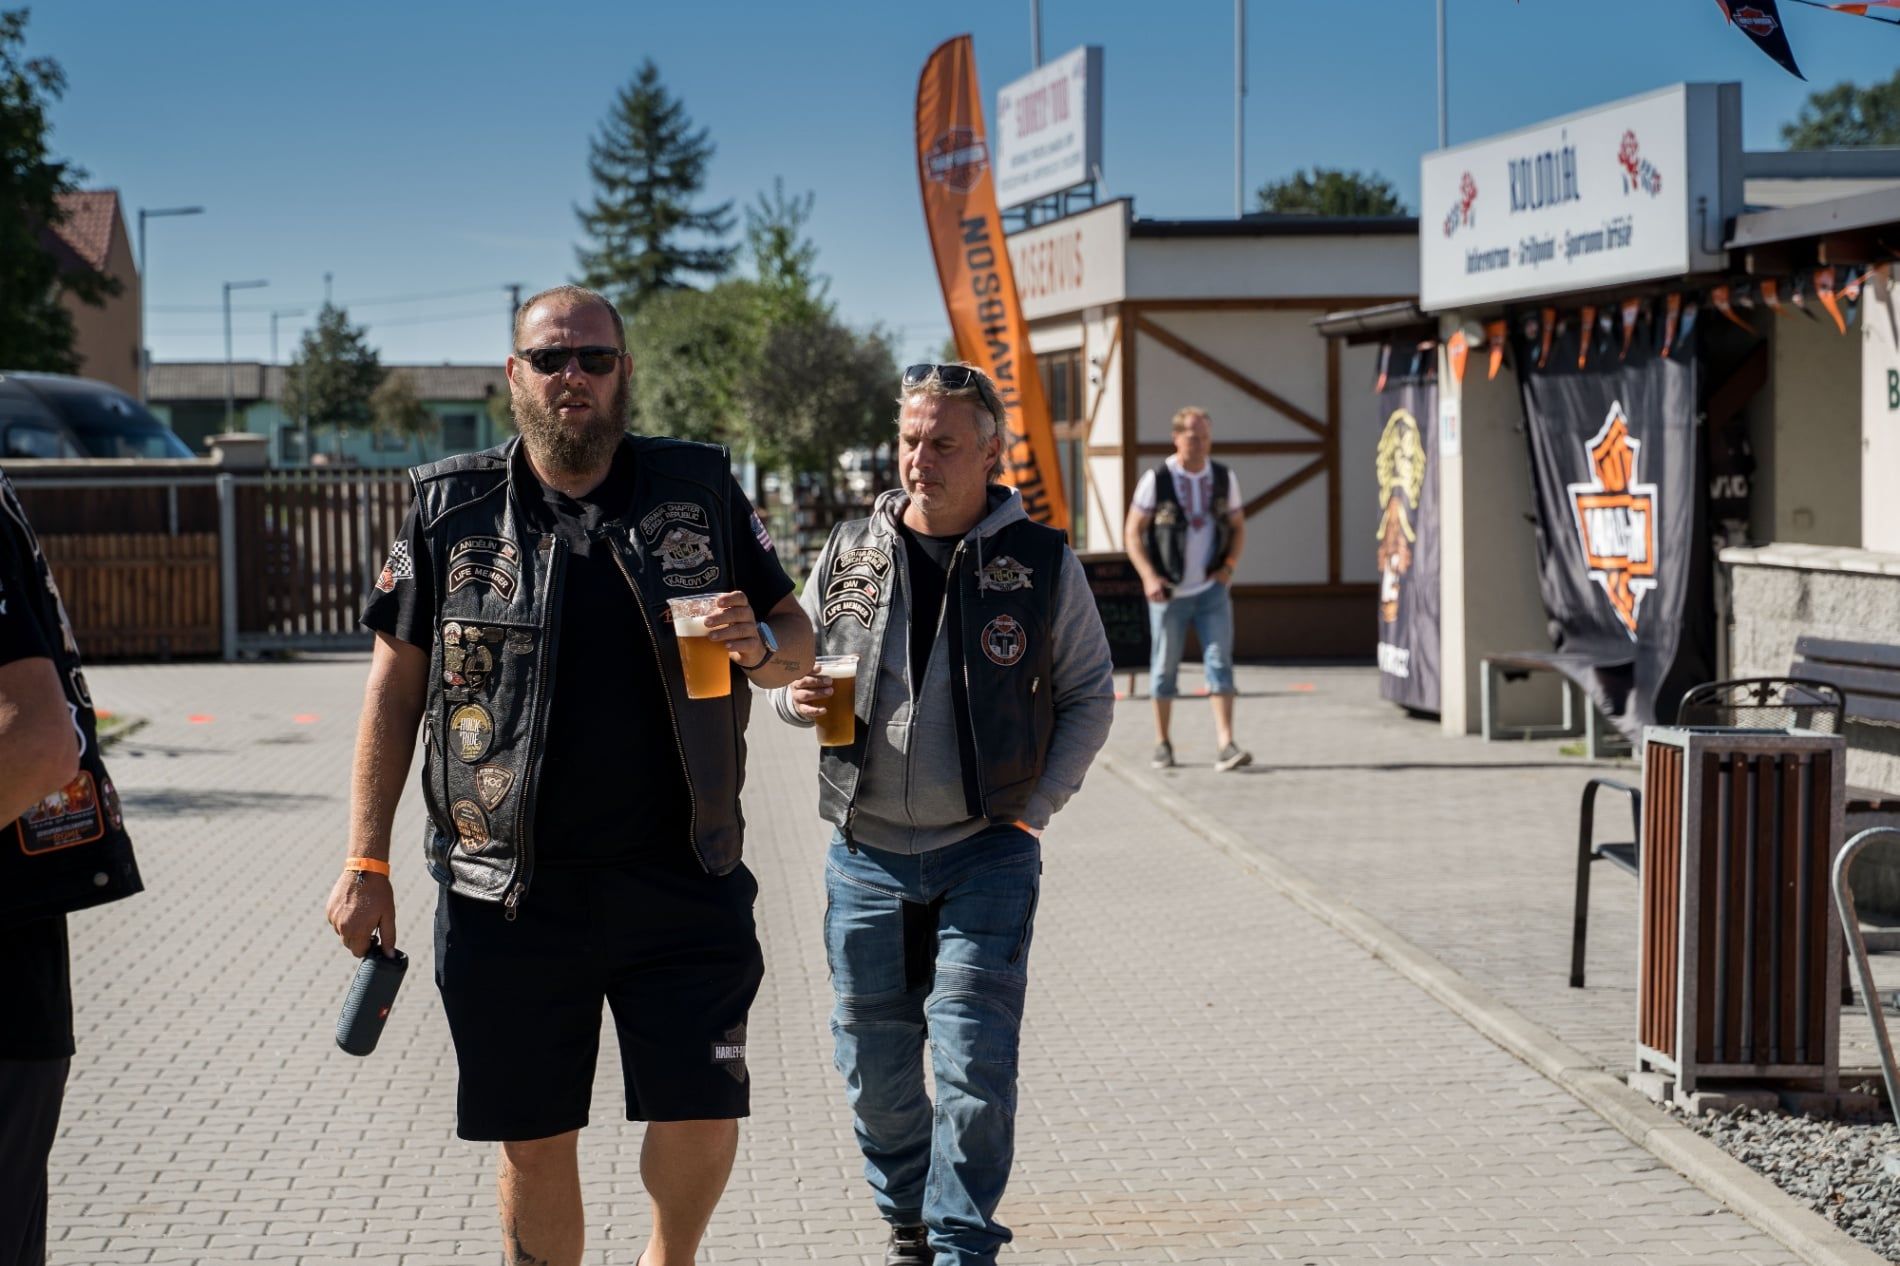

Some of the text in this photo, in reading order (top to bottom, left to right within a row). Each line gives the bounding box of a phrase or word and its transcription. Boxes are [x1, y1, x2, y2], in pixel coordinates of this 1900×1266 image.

[454, 567, 509, 589] LIFE MEMBER
[827, 602, 869, 618] LIFE MEMBER
